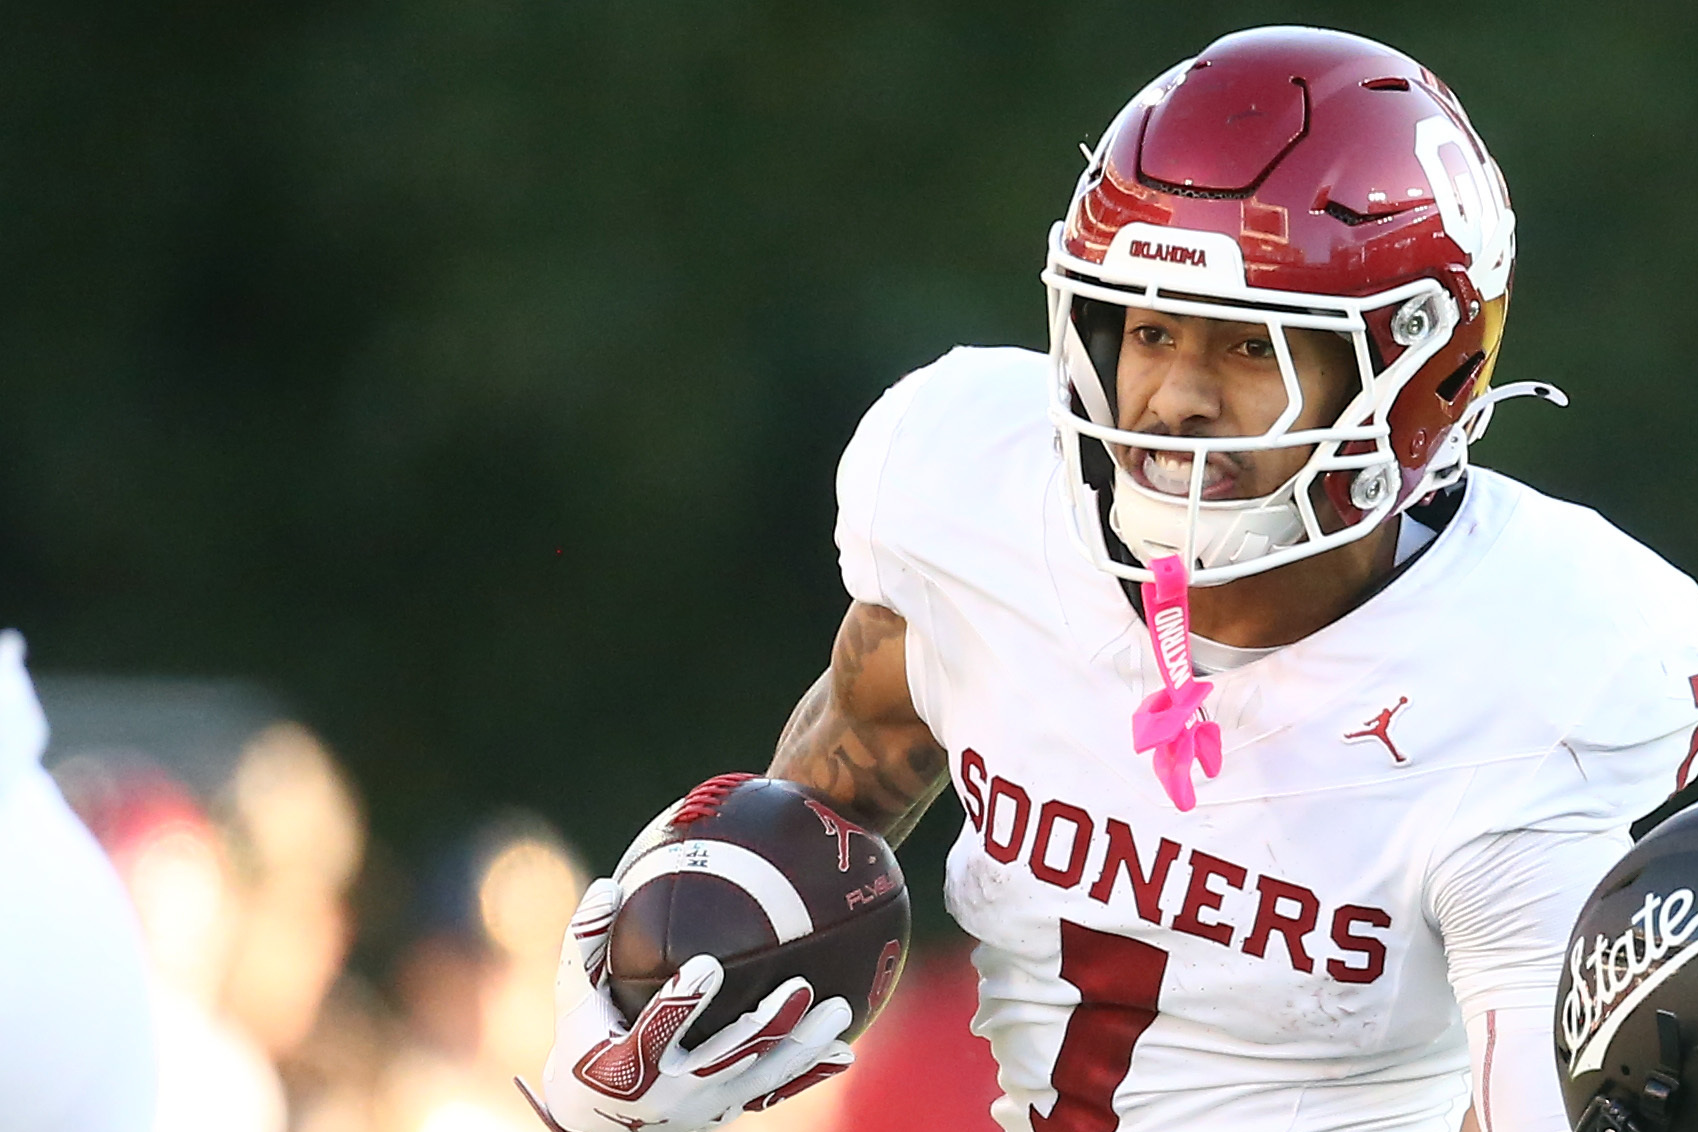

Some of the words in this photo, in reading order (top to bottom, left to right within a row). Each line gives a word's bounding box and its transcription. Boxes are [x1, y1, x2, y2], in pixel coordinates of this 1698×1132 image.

[1129, 239, 1207, 268] OKLAHOMA
[1153, 605, 1191, 690] NXTRND
[958, 746, 1392, 986] SOONERS
